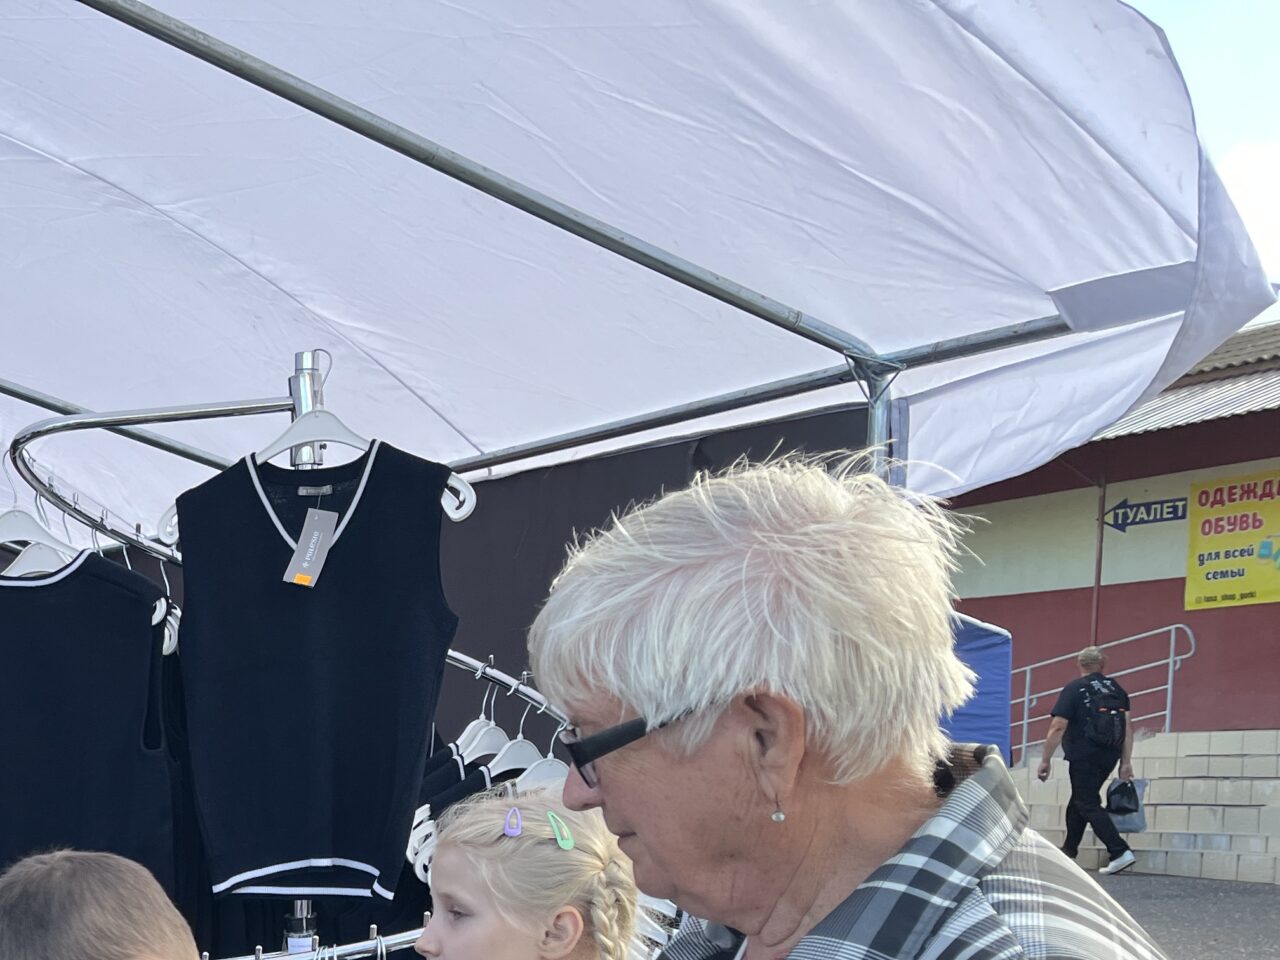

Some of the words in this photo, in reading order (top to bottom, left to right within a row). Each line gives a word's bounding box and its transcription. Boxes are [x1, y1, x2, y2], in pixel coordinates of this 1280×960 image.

[1198, 479, 1280, 508] ОДЕЖД
[1115, 501, 1186, 524] ТУАЛЕТ
[1200, 512, 1264, 536] ОБУВЬ
[1198, 551, 1221, 567] для
[1224, 544, 1254, 560] всей
[1205, 568, 1245, 581] семьи
